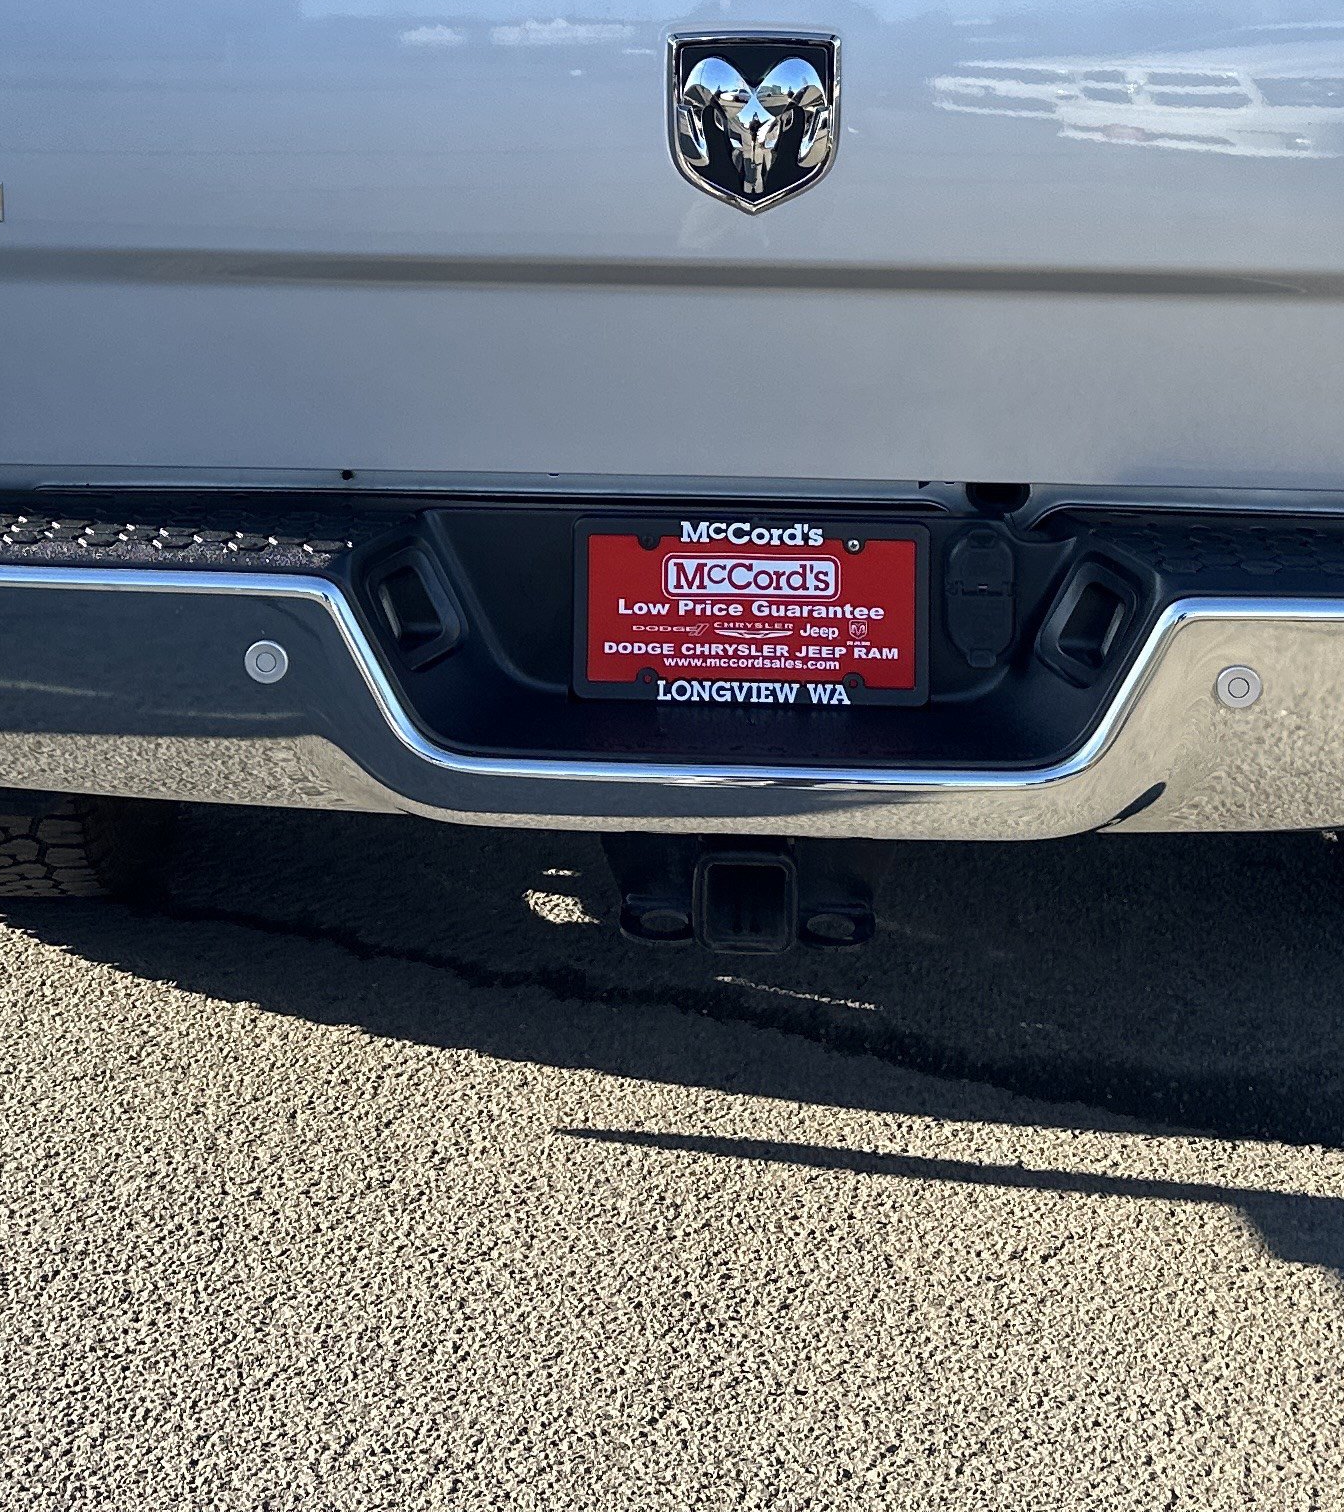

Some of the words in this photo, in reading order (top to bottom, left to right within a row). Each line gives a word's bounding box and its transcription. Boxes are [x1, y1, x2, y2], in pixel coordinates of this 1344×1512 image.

[680, 520, 824, 547] McCord's
[673, 561, 830, 593] McCord's
[618, 599, 670, 616] Low
[678, 600, 744, 617] Price
[751, 601, 885, 620] Guarantee
[632, 625, 698, 633] DODGE
[713, 622, 794, 630] CHRYSLER
[799, 623, 840, 640] Jeep
[604, 642, 675, 655] DODGE
[681, 643, 790, 657] CHRYSLER
[795, 645, 847, 658] JEEP
[853, 647, 899, 660] RAM
[663, 656, 840, 670] www.mccordsales.com
[657, 679, 800, 703] LONGVIEW
[806, 684, 851, 705] WA
